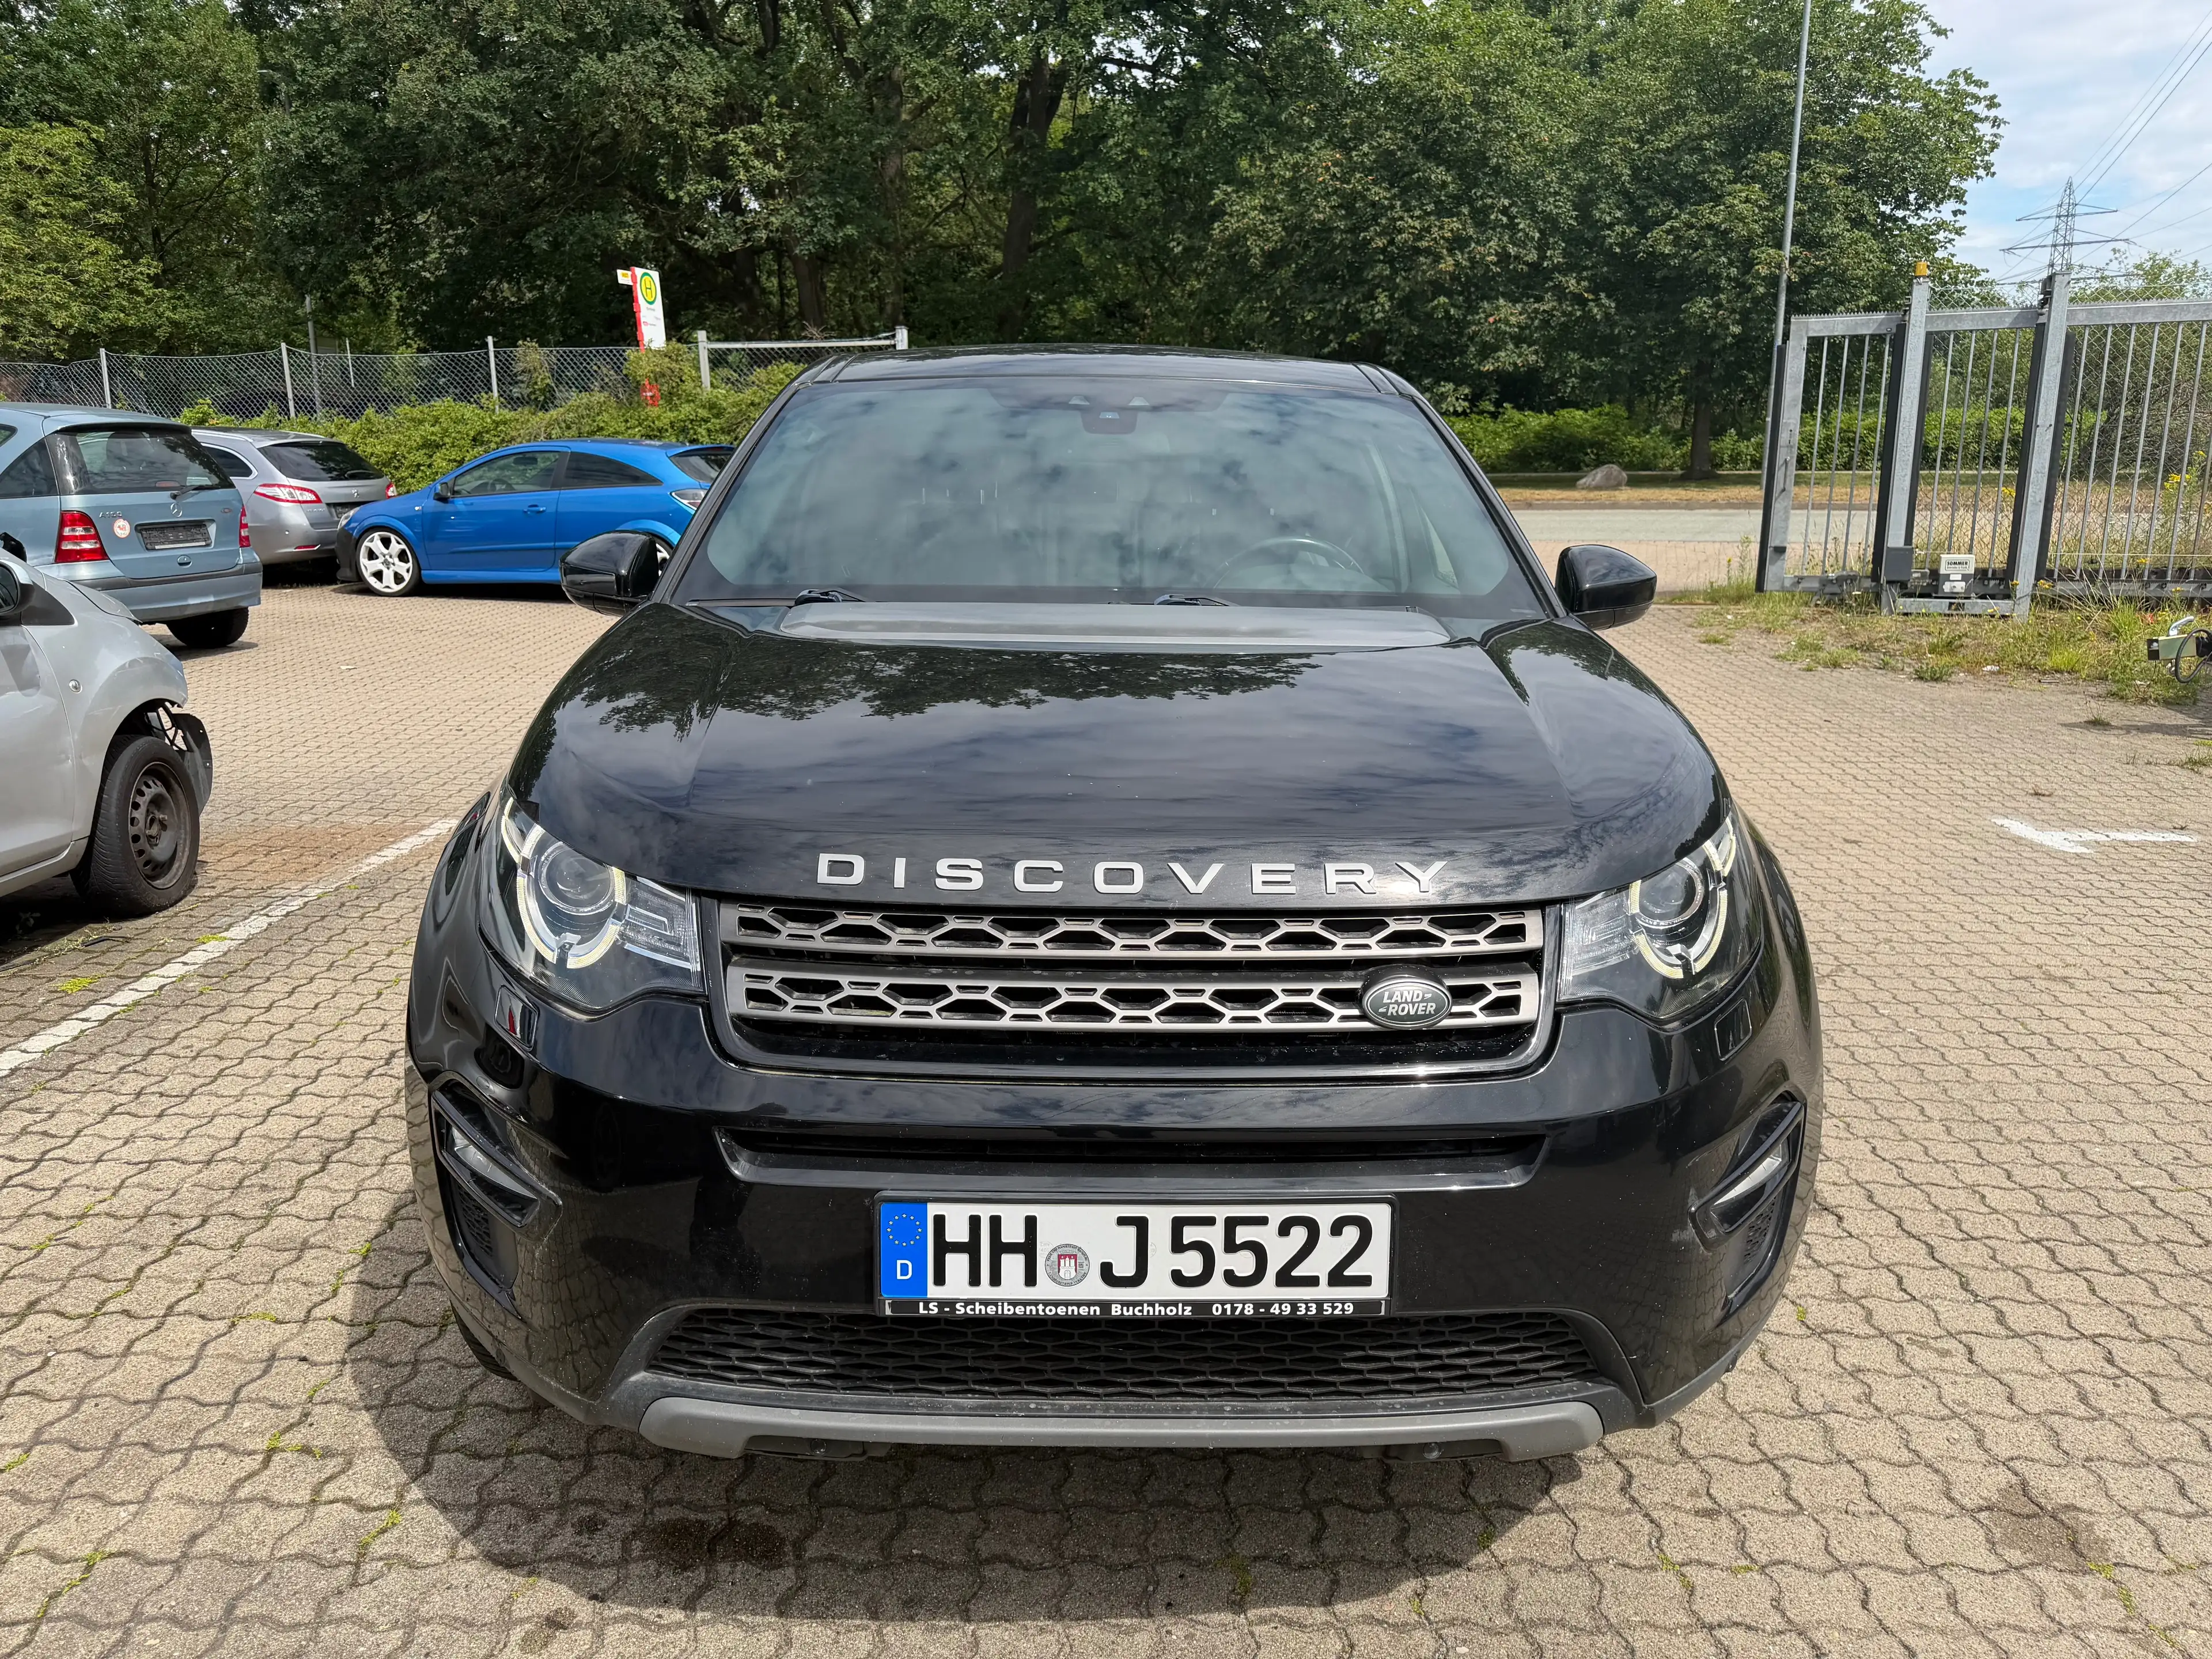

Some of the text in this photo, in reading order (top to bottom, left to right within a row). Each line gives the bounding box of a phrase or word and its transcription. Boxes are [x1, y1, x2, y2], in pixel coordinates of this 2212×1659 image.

[643, 278, 653, 299] H
[817, 851, 1448, 895] DISCOVERY
[1382, 990, 1423, 1003] LAND
[1387, 1002, 1437, 1016] ROVER
[933, 1214, 1037, 1287] HH
[896, 1260, 912, 1279] D
[919, 1302, 938, 1315] LS
[955, 1302, 1100, 1316] Scheibentoenen
[1111, 1303, 1192, 1316] Buchholz
[1212, 1303, 1254, 1315] 0178
[1270, 1303, 1291, 1315] 49
[1296, 1303, 1317, 1315] 33
[1323, 1302, 1354, 1315] 529
